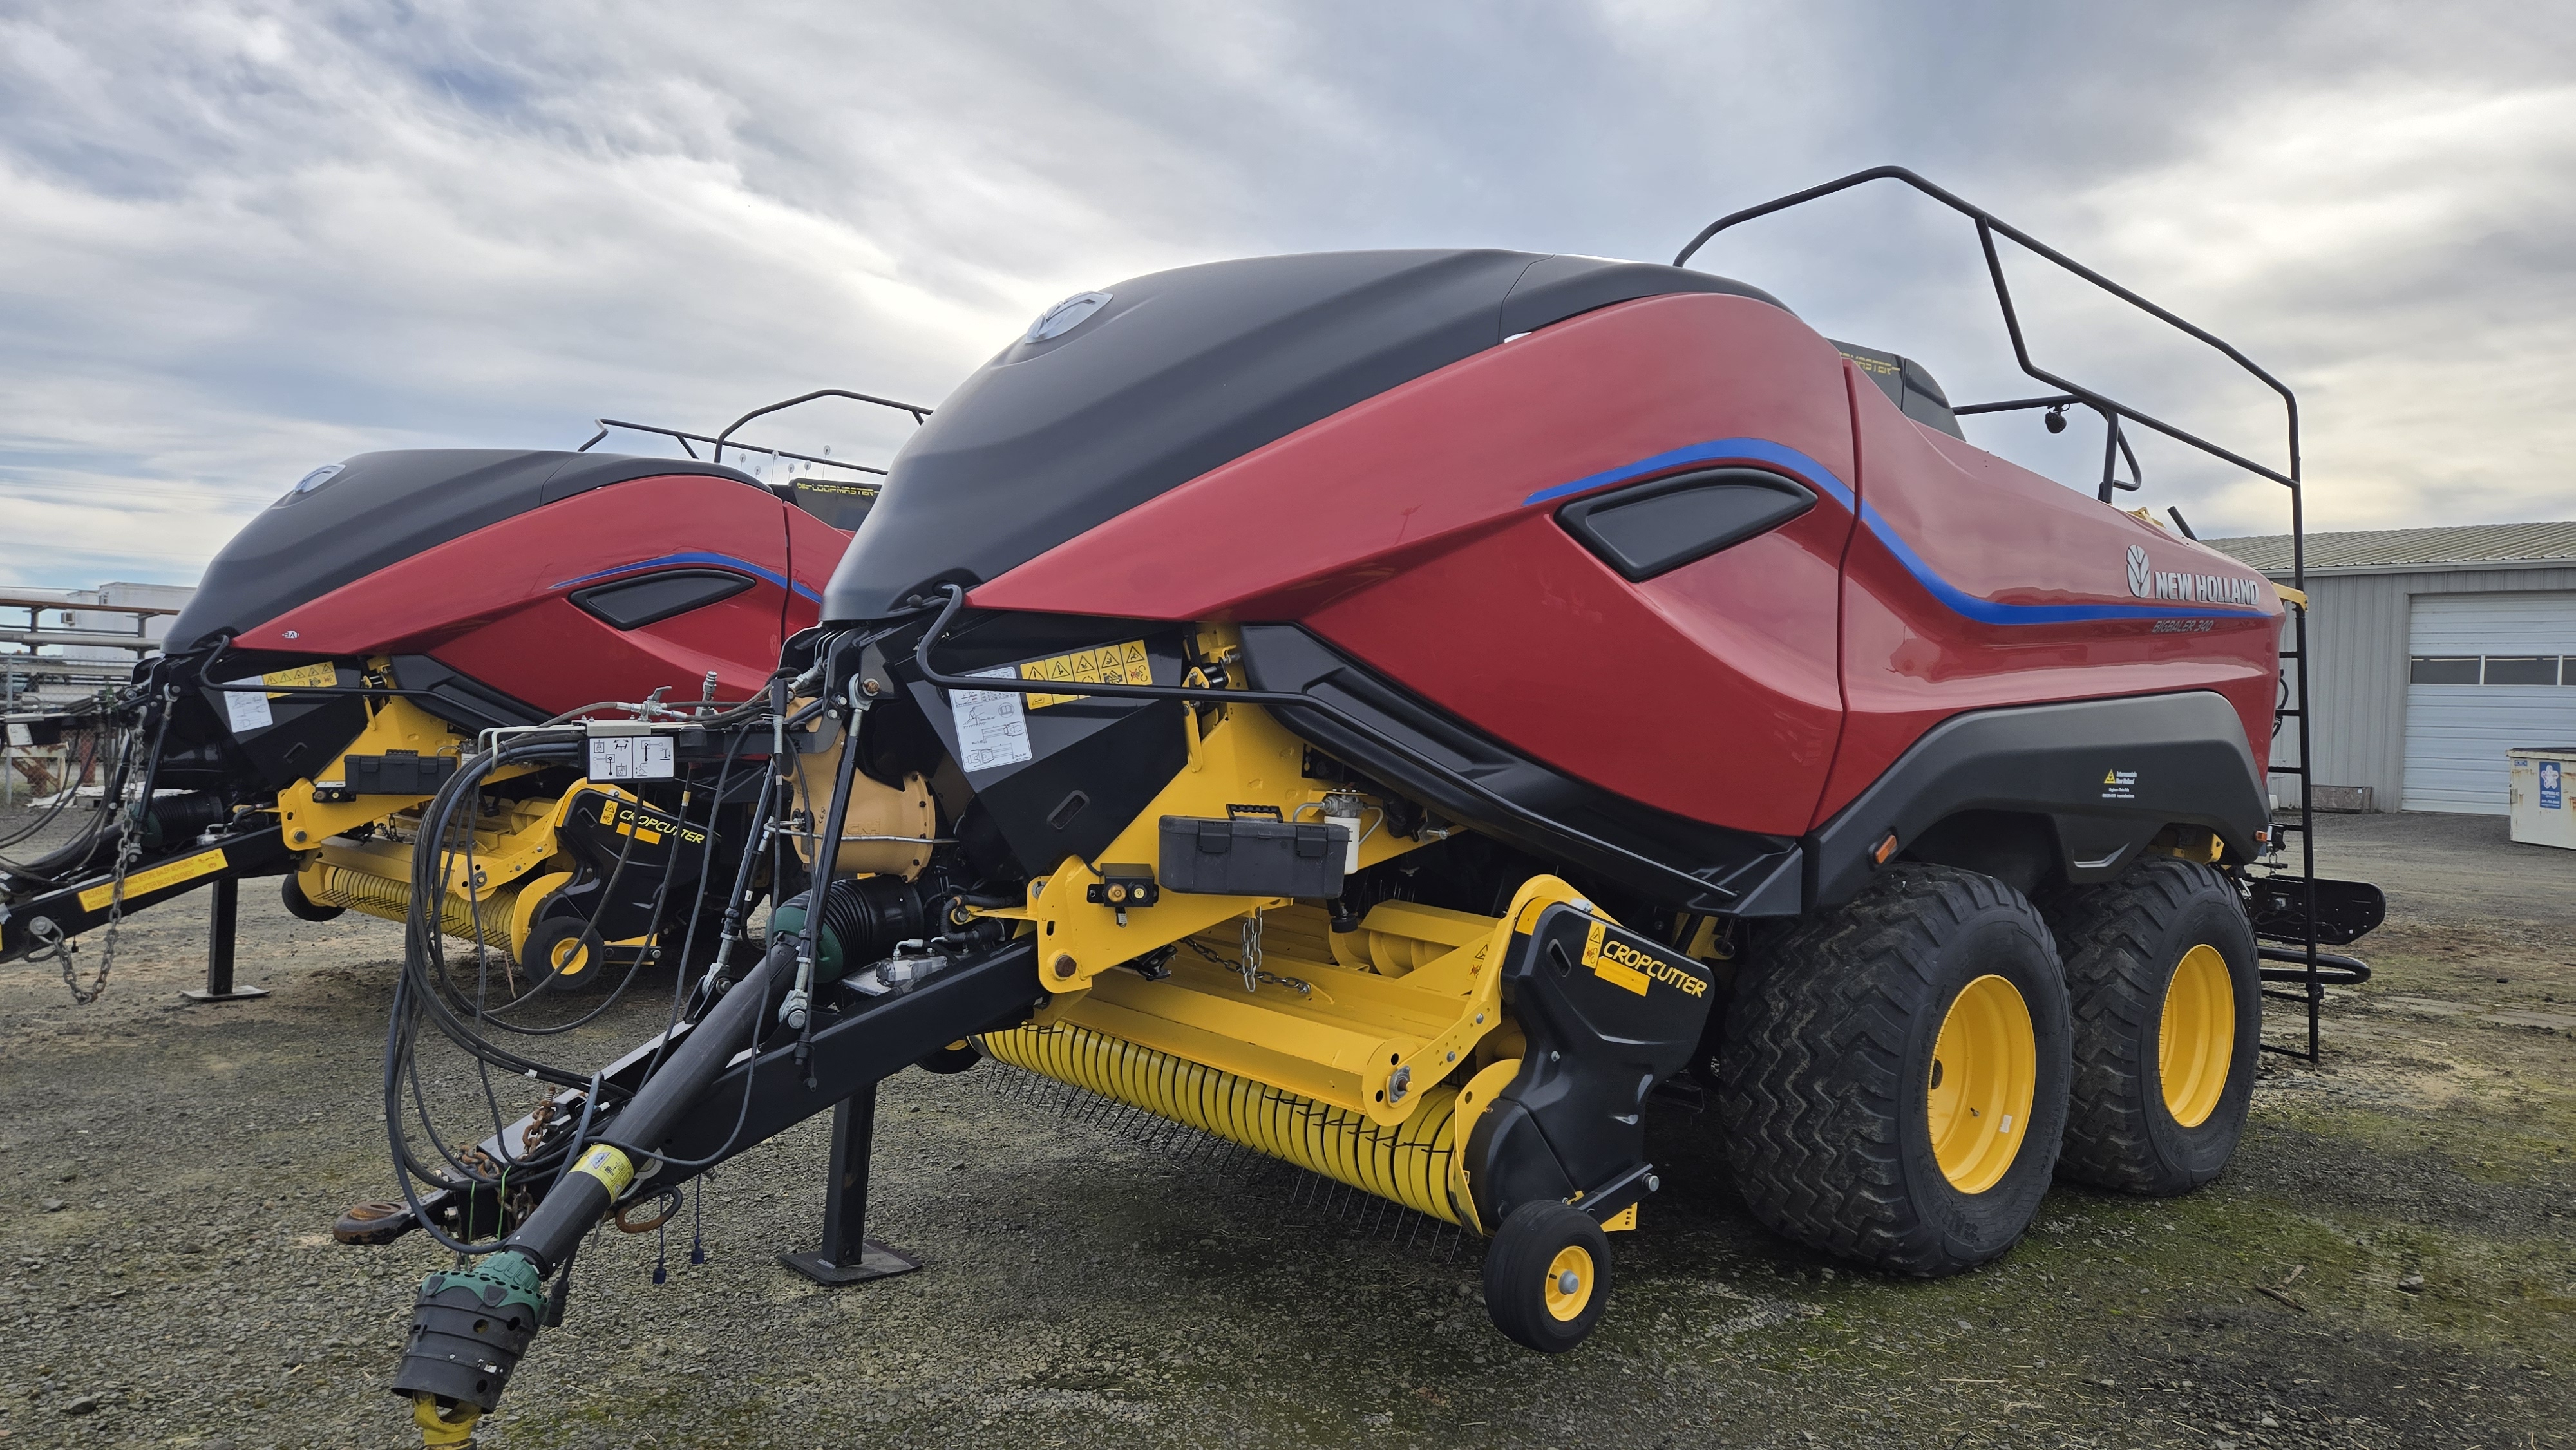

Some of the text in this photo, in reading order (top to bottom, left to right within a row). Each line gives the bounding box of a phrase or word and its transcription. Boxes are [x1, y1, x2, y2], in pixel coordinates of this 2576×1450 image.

[2154, 571, 2260, 605] NEW HOLLAND
[2152, 620, 2214, 632] BIGBALER 340
[1603, 940, 1707, 998] CROPCUTTER
